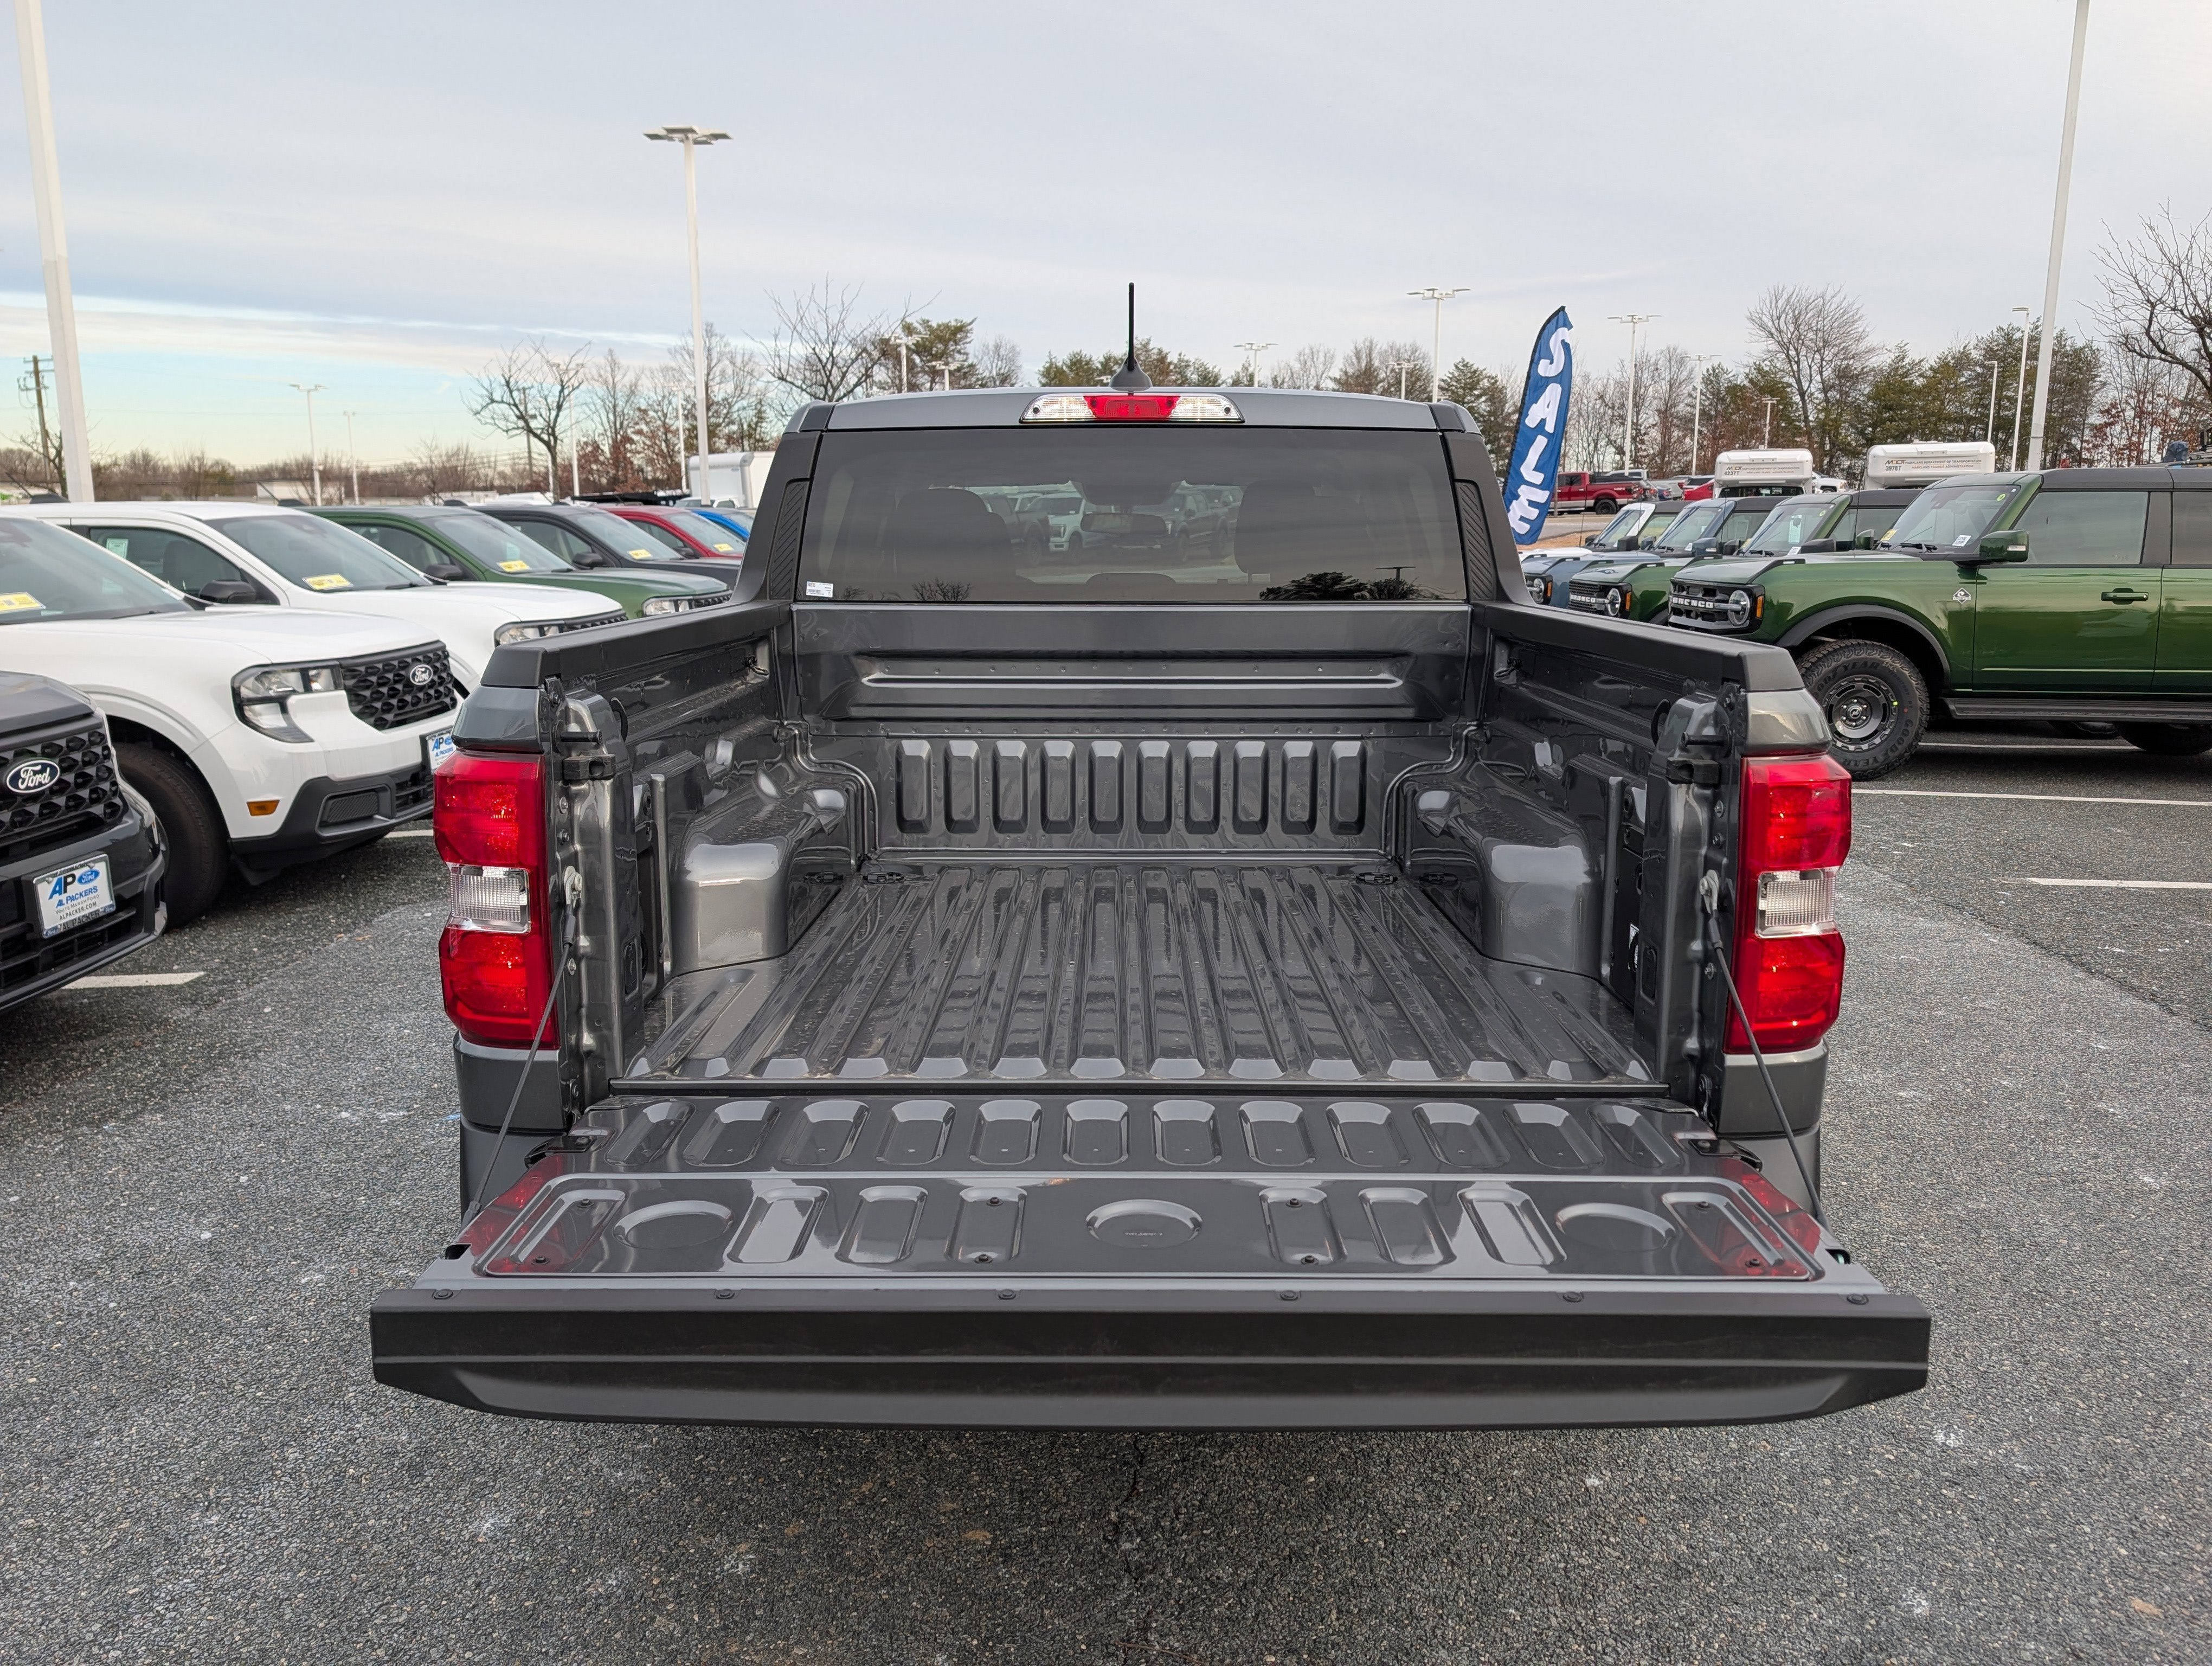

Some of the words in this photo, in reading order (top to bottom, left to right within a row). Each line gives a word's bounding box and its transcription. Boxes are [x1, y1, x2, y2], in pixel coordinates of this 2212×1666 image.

[1508, 327, 1571, 535] SALE
[1570, 594, 1596, 603] BRONCO
[1673, 597, 1713, 608] BRONCO
[432, 736, 444, 752] AP
[18, 764, 51, 790] Ford
[48, 873, 76, 900] AP
[56, 899, 65, 908] AL
[59, 901, 97, 921] ALPACKER.COM
